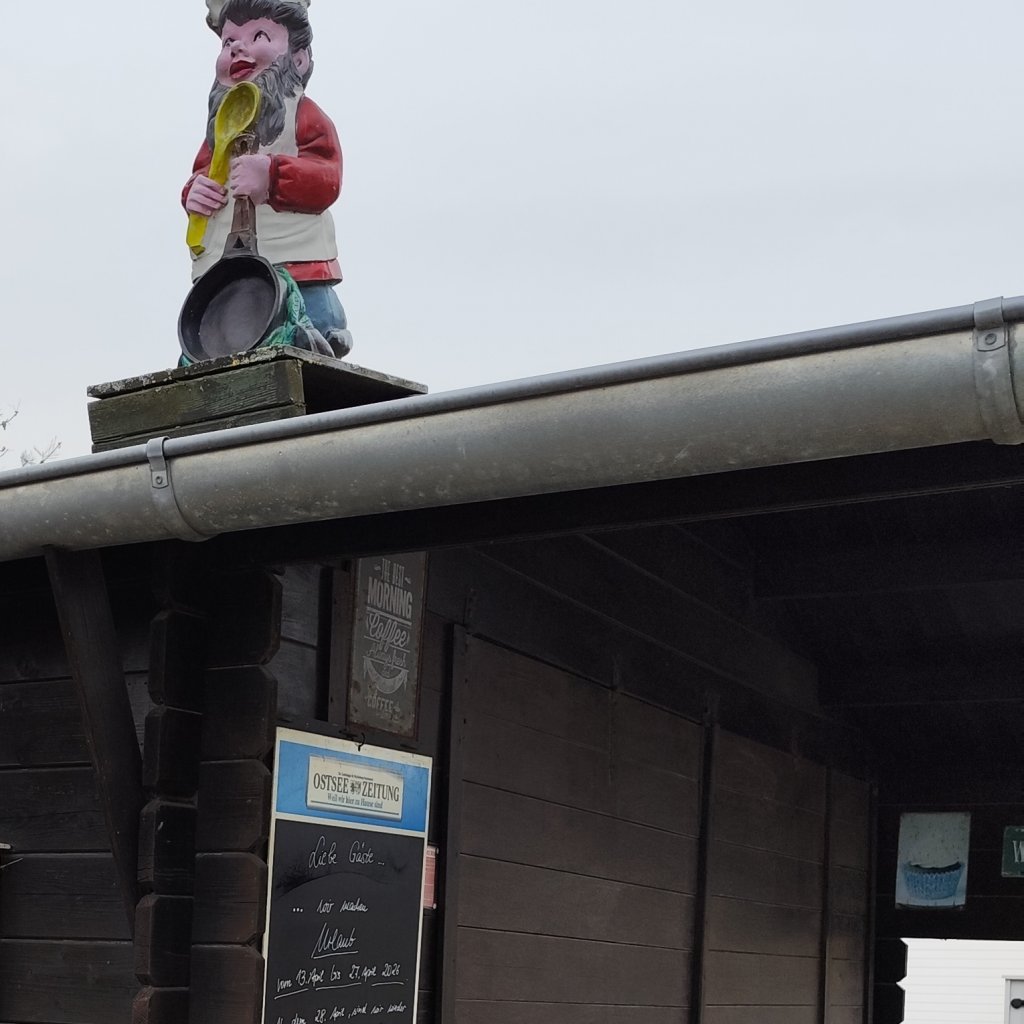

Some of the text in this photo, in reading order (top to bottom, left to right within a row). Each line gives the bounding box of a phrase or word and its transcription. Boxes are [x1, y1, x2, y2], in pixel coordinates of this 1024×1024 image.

[368, 575, 413, 619] MORNING
[313, 772, 349, 794] OSTSEE
[361, 780, 400, 802] ZEITUNG
[308, 835, 337, 868] Liebe
[348, 840, 374, 864] Gäste
